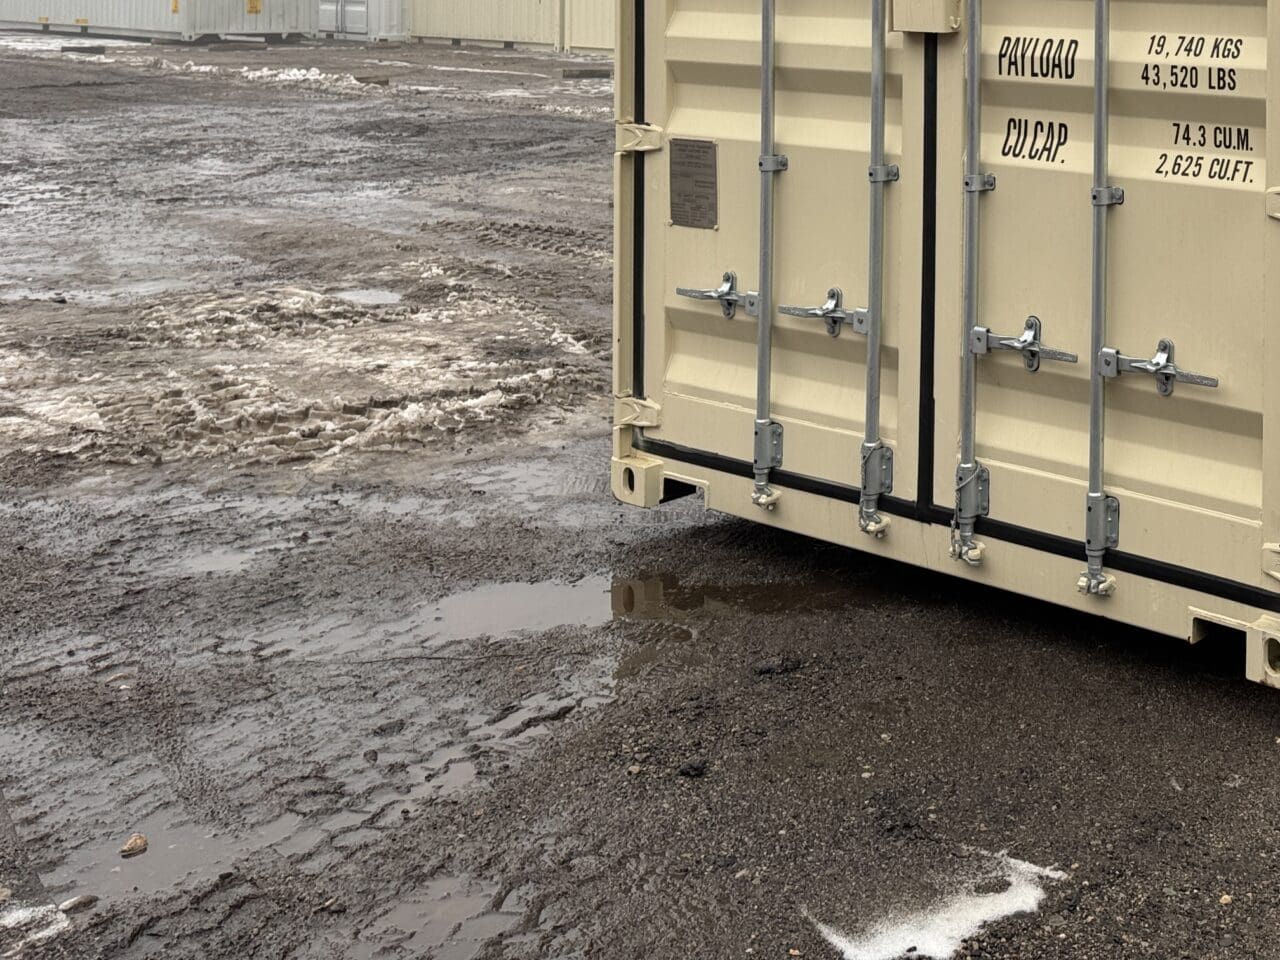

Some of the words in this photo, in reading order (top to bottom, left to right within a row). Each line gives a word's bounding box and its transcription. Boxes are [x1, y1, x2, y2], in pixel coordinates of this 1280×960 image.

[998, 36, 1079, 80] PAYLOAD
[1147, 35, 1204, 59] 19,740
[1210, 38, 1243, 60] KGS
[1141, 64, 1199, 90] 43,520
[1208, 67, 1237, 91] LBS
[1001, 117, 1068, 164] CU.CAP.
[1172, 123, 1207, 147] 74.3
[1213, 126, 1254, 152] CU.M.
[1155, 153, 1204, 178] 2,625
[1208, 158, 1254, 183] CU.FT.
